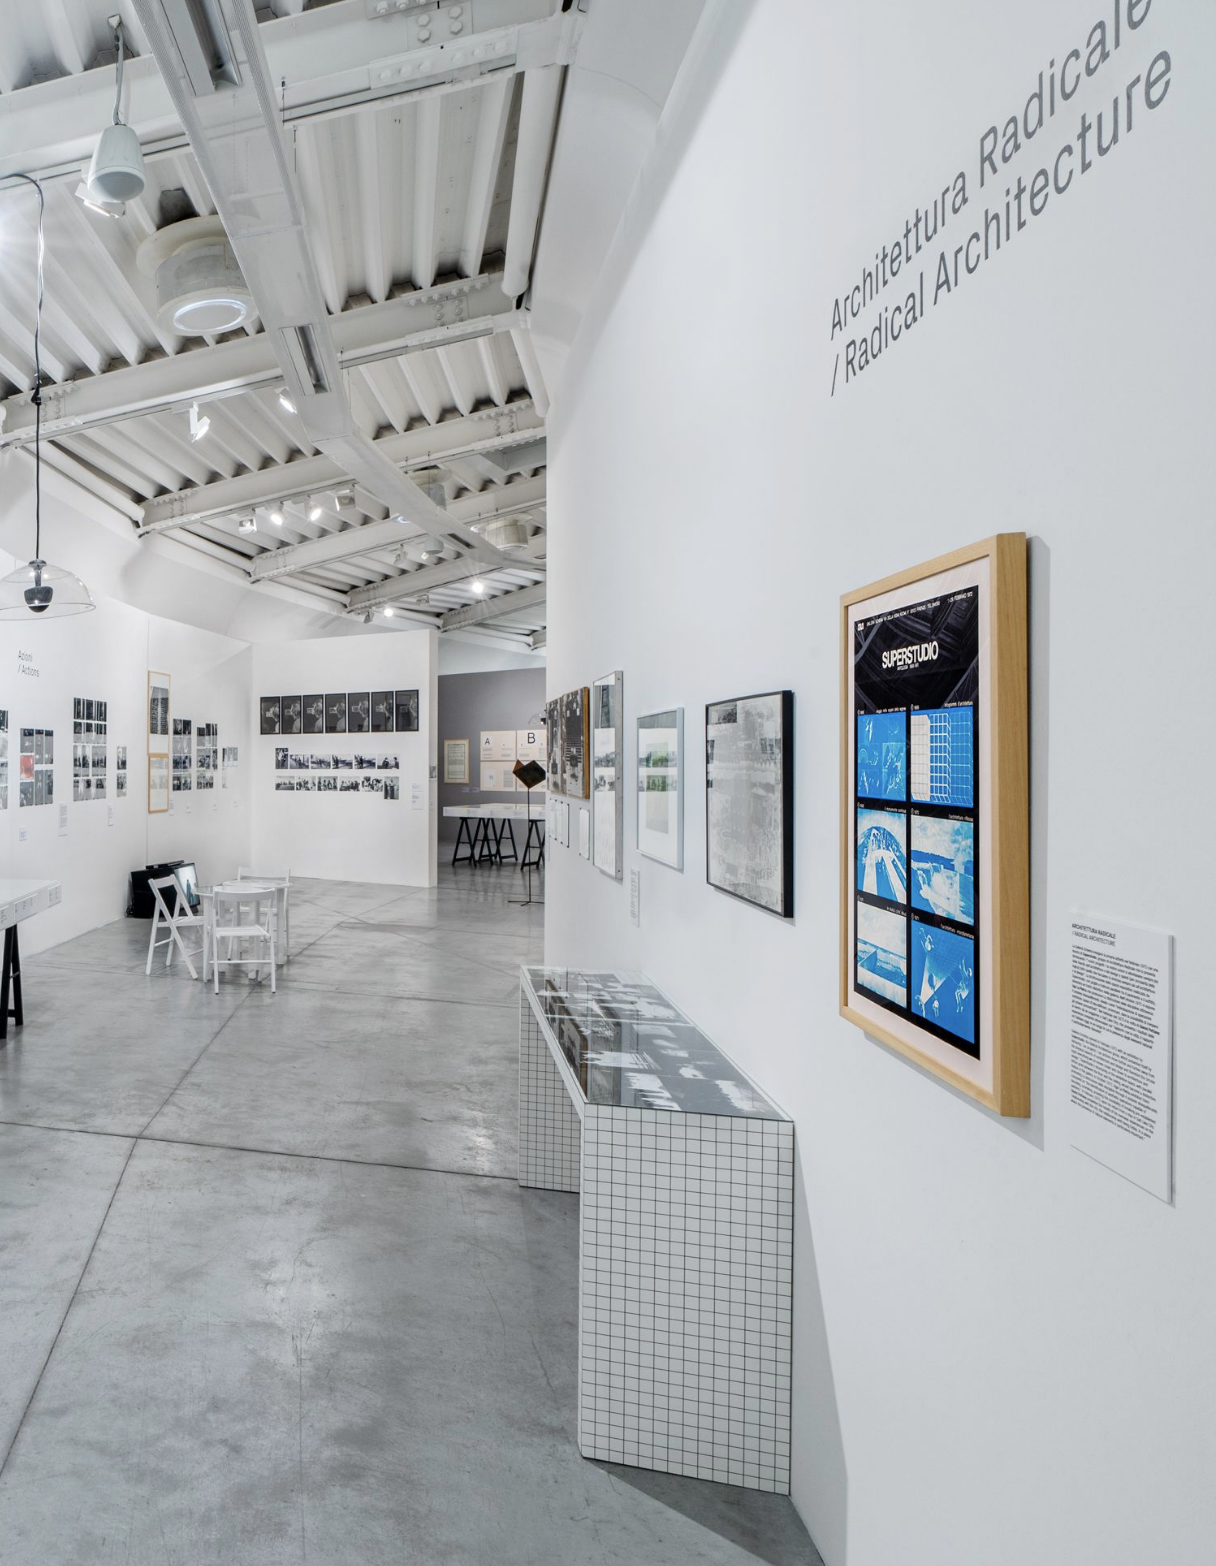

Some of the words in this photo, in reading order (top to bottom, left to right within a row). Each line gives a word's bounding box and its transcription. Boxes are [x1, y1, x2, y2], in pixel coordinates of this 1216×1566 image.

[831, 353, 840, 397] /
[845, 272, 924, 383] Radical
[933, 50, 1172, 306] Architecture
[831, 171, 969, 340] Architettura
[881, 640, 939, 669] SUPERSTUDIO
[527, 733, 536, 744] B
